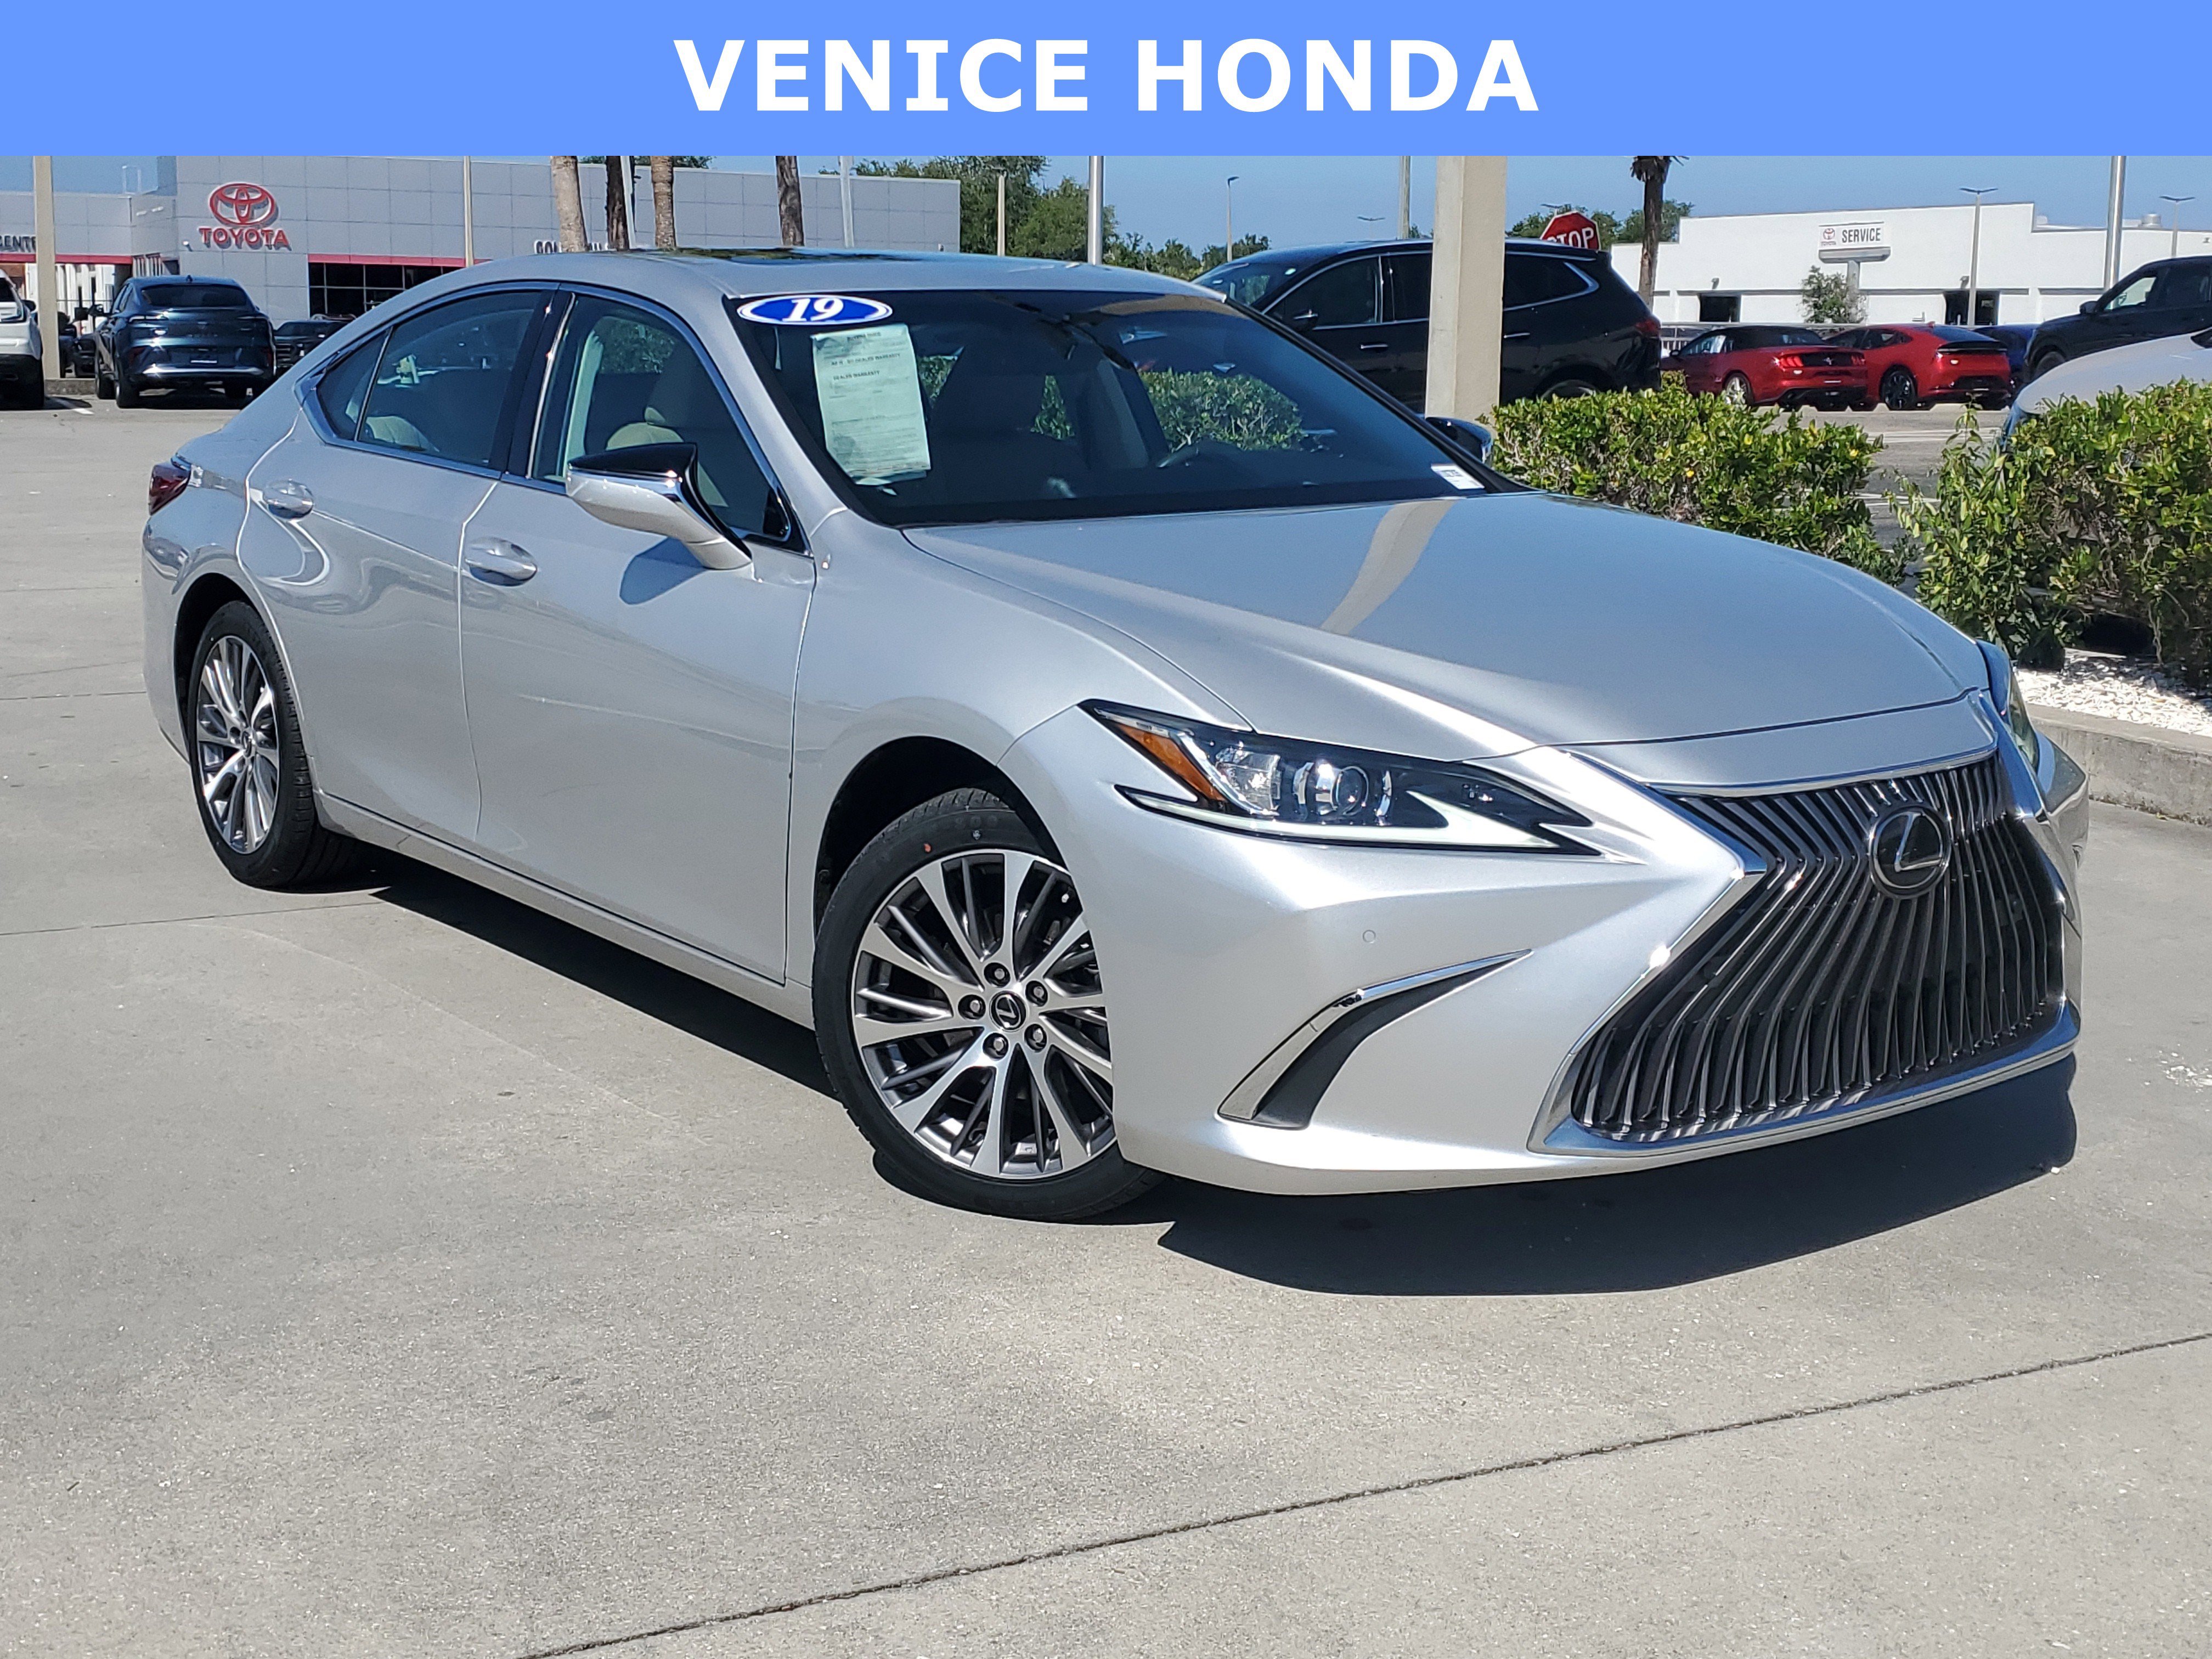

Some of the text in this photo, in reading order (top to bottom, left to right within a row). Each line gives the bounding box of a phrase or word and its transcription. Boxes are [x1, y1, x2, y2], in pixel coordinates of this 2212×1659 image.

[199, 227, 291, 248] TOYOTA
[1842, 228, 1881, 243] SERVICE
[782, 298, 844, 321] 19
